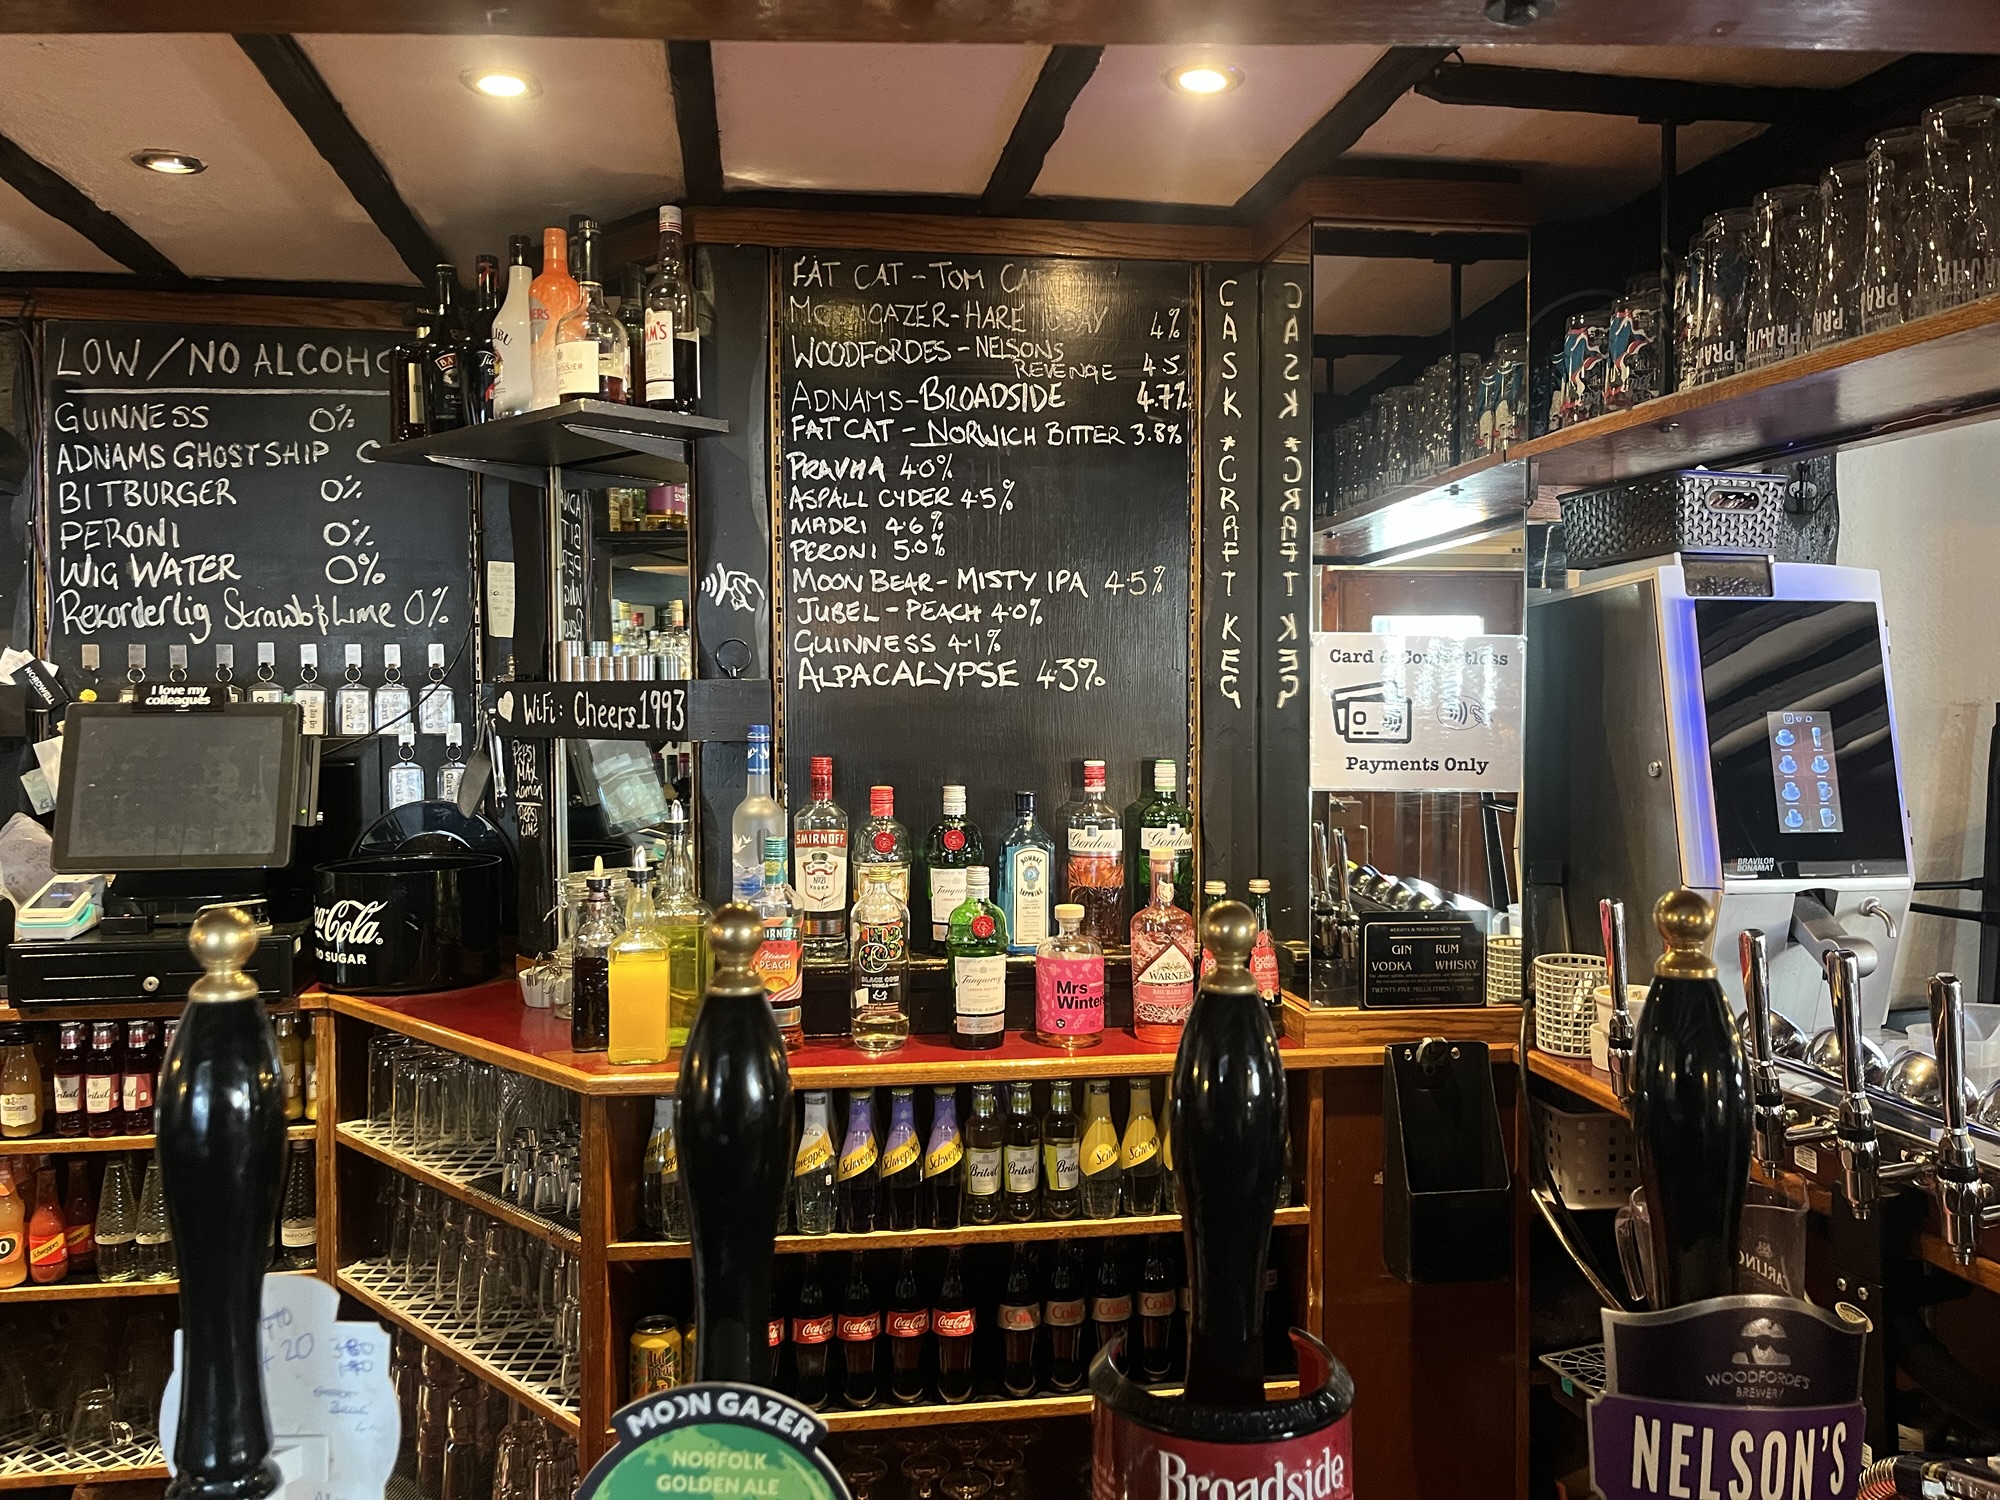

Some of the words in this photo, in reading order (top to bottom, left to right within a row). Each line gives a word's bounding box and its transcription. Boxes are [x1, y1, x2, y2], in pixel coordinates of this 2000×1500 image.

[792, 256, 841, 289] FAT
[854, 262, 903, 290] CAT
[929, 261, 985, 291] TOM
[1150, 307, 1180, 339] 4%
[57, 337, 142, 377] LOW
[190, 341, 240, 377] NO
[792, 335, 952, 369] WOODFORDES
[975, 337, 1065, 361] NELSONS
[1219, 279, 1242, 419] CASK
[55, 403, 210, 434] GUINNESS
[308, 405, 356, 433] 0%
[792, 416, 842, 442] FAT
[843, 418, 894, 443] CAT
[912, 417, 1037, 448] NORWICH
[1045, 423, 1126, 445] BITTER
[1130, 423, 1183, 446] 3.8%
[57, 441, 165, 475] ADNAMS
[786, 452, 886, 483] PRAVHA
[59, 478, 237, 514] BITBURGER
[320, 475, 363, 502] 0%
[788, 486, 869, 511] ASPALL
[878, 487, 954, 509] CYDER
[59, 519, 180, 551] PERONI
[322, 520, 374, 548] 0%
[790, 517, 867, 537] MADRI
[789, 541, 877, 564] PERONI
[59, 554, 119, 589] WIG
[130, 553, 241, 590] WATER
[325, 552, 386, 588] 0%
[791, 568, 865, 593] MOON
[957, 568, 1038, 592] MISTY
[1047, 569, 1090, 598] IPA
[56, 588, 213, 644] Rekorderlig
[404, 585, 450, 627] 0%
[797, 599, 880, 625] JUBEL
[906, 600, 982, 624] PEACH
[794, 629, 937, 659] GUINNESS
[1330, 649, 1375, 664] Card
[24, 665, 56, 706] NORDWELL
[798, 659, 1021, 692] ALPACALYPSE
[145, 693, 212, 708] colleagues
[158, 685, 185, 696] love
[187, 686, 208, 700] my
[1346, 756, 1439, 774] Payments
[1444, 757, 1489, 776] Only
[796, 832, 845, 845] SMIRNOFF
[1736, 864, 1775, 872] BONAMAT
[1737, 857, 1775, 865] BRAVILOR
[325, 951, 367, 965] SUGAR
[1391, 945, 1412, 954] GIN
[1435, 944, 1459, 954] RUM
[759, 959, 792, 971] PEACH
[1372, 961, 1412, 971] VODKA
[1435, 960, 1479, 970] WHISKY
[1056, 980, 1088, 993] Mrs
[843, 1318, 876, 1335] Coca-Cola
[893, 1315, 926, 1330] Coca-Cola
[937, 1314, 971, 1330] Coca-Cola
[716, 1392, 816, 1445] GAZER
[672, 1451, 767, 1471] NORFOLK
[1631, 1414, 1847, 1500] NELSON'S
[655, 1474, 739, 1495] GOLDEN
[742, 1478, 780, 1496] ALE
[1158, 1446, 1344, 1500] Broadside
